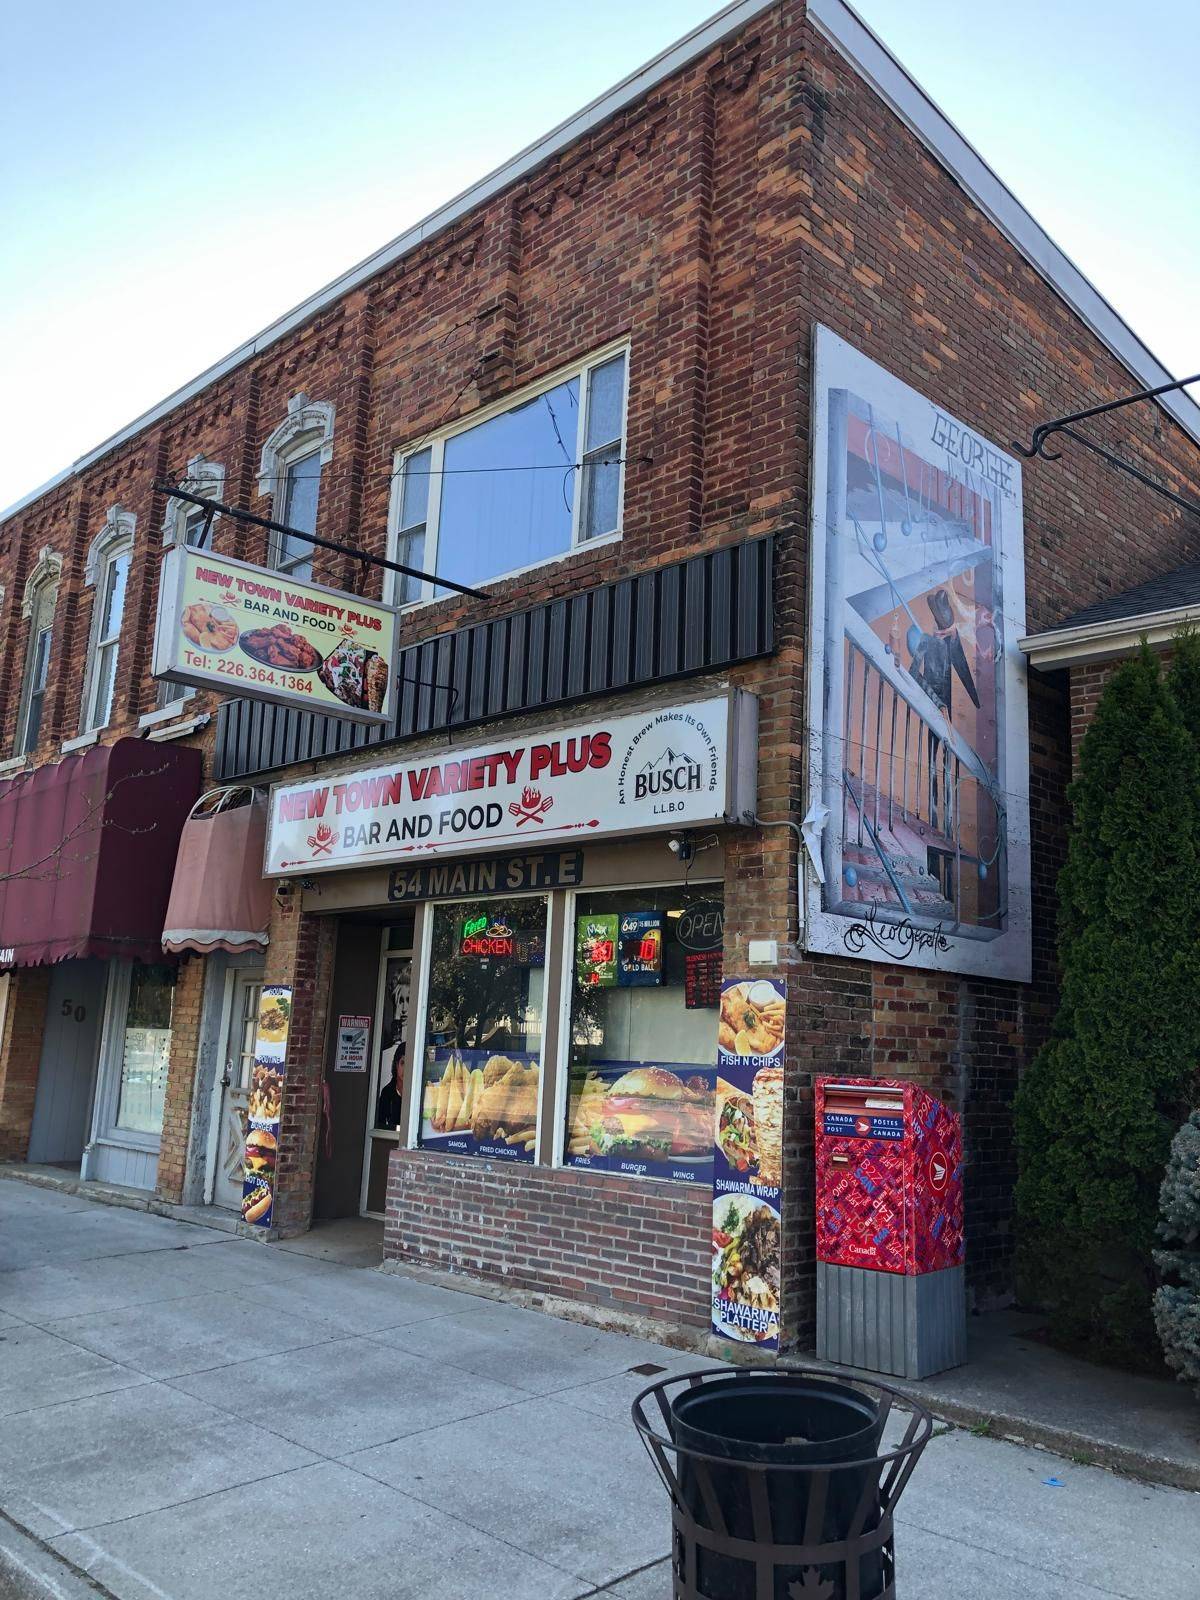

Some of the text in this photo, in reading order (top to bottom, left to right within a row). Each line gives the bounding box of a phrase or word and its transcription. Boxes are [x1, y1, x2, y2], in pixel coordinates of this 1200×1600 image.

[195, 566, 382, 631] NEW TOWN VARIETY PLUS
[244, 599, 336, 632] BAR AND FOOD
[184, 650, 313, 693] Tel: 226.364.1364
[618, 712, 719, 805] An Honest Brew Makes Its Own Friends
[279, 731, 612, 824] NEW TOWN VARIETY PLUS
[634, 764, 702, 799] BUSCH
[653, 801, 685, 814] L.L.B.O
[343, 802, 503, 849] BAR AND FOOD
[393, 852, 577, 899] 54 MAIN ST. E
[622, 919, 638, 932] 649
[679, 911, 723, 939] OPEN
[462, 939, 513, 954] CHICKEN
[61, 1000, 86, 1023] 50
[341, 1018, 369, 1028] WARNING
[258, 1055, 281, 1064] POUTINE
[721, 1055, 781, 1068] FISH N CHIPS
[826, 1115, 853, 1123] CANADA
[873, 1118, 898, 1126] POSTES
[250, 1122, 273, 1132] BURGER
[447, 1140, 468, 1149] SAMOSA
[479, 1145, 518, 1156] FRIED CHICKEN
[574, 1157, 591, 1165] FRIES
[621, 1162, 647, 1173] BURGER
[245, 1175, 269, 1188] HOT DOG
[673, 1170, 695, 1181] WINGS
[716, 1178, 779, 1199] SHAWARMA WRAP
[849, 1244, 877, 1255] Canada
[714, 1297, 777, 1325] SHAWARMA
[720, 1311, 768, 1333] PLATTER
